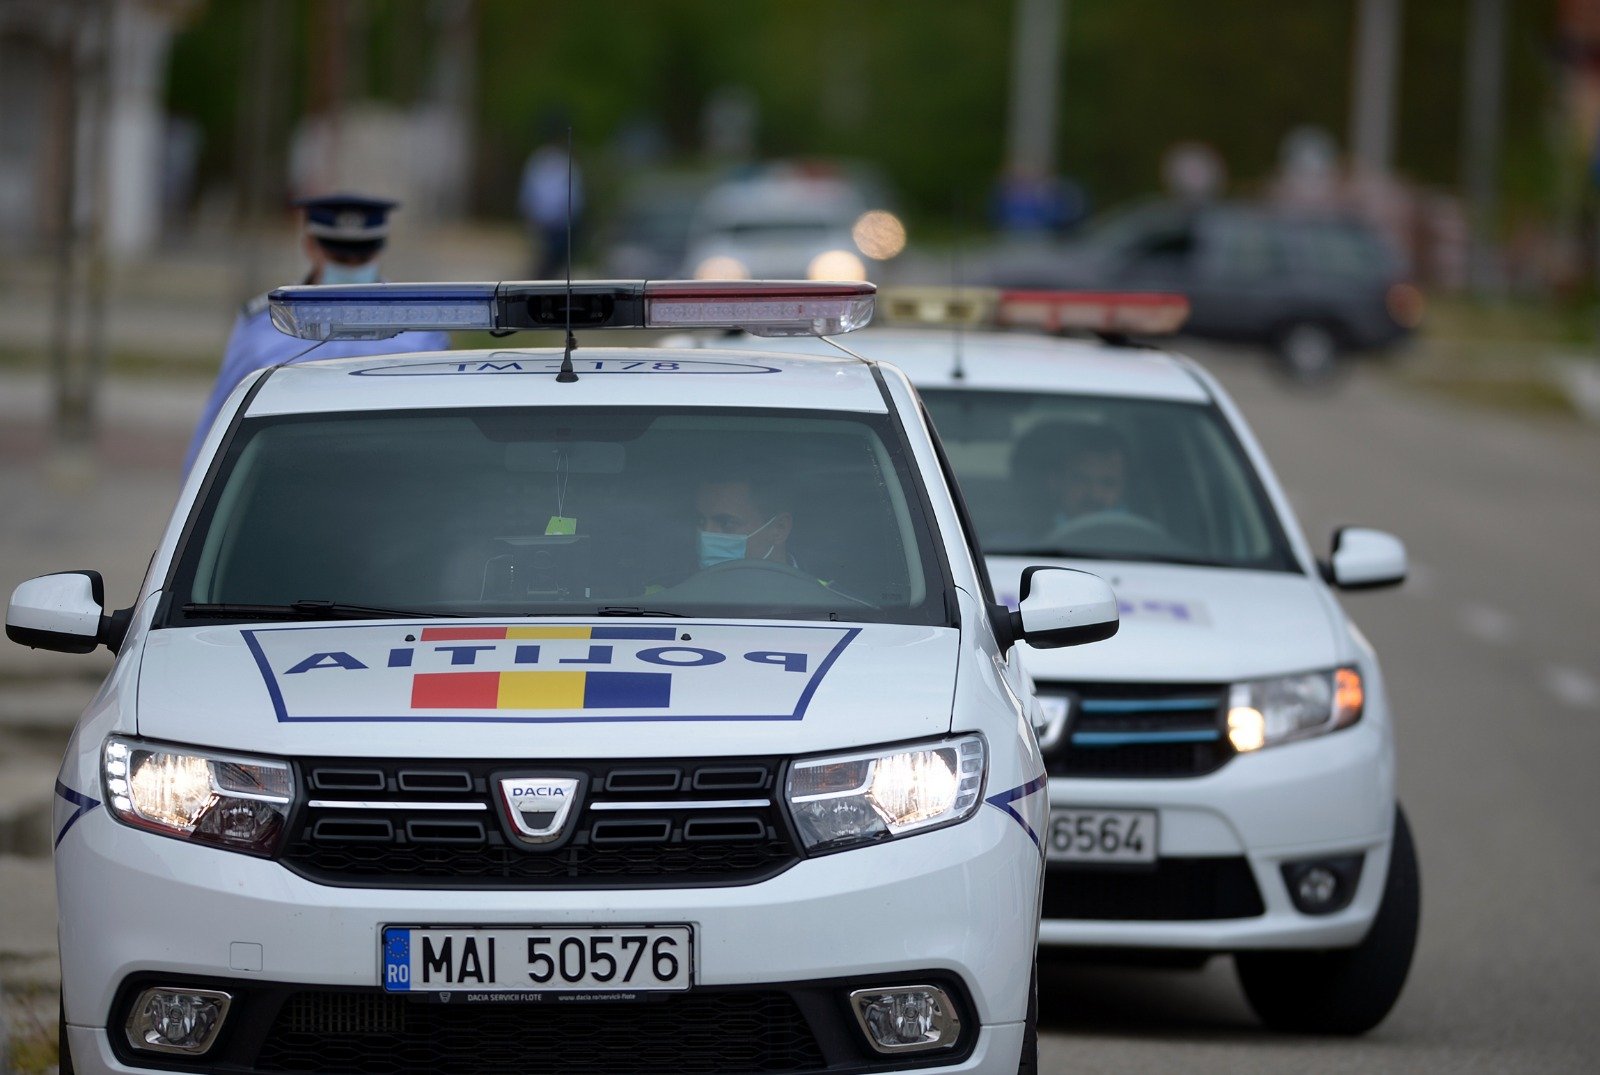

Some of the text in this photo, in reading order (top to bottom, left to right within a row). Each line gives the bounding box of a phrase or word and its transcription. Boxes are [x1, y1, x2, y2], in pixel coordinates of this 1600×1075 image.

[449, 361, 523, 372] TM
[588, 361, 681, 371] 178
[512, 787, 565, 797] DACIA
[1052, 815, 1143, 853] 6564
[421, 936, 679, 983] MAI 50576
[387, 964, 410, 983] RO
[467, 993, 542, 1001] DACIA SERVICII FLOTE
